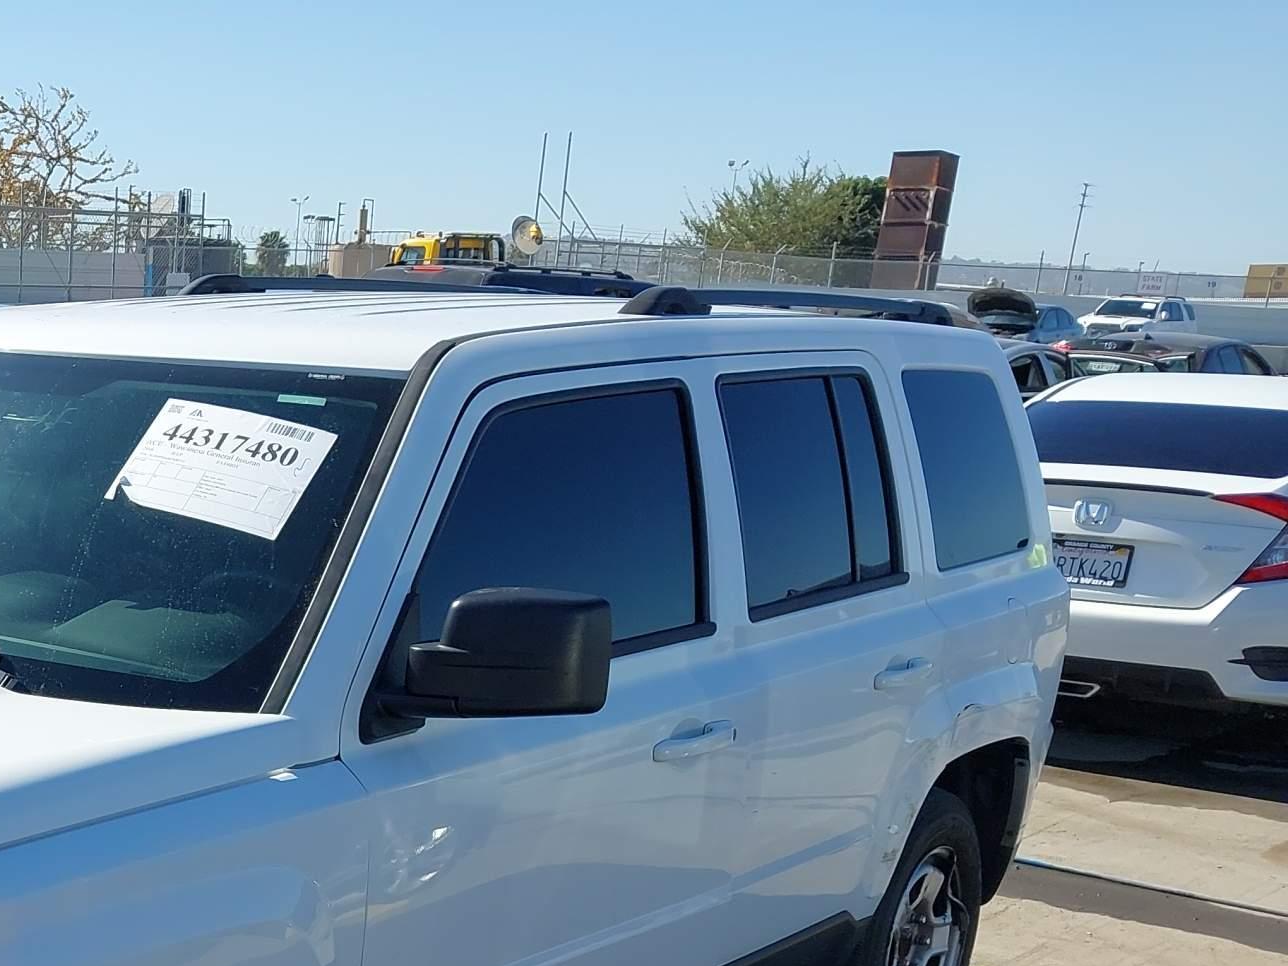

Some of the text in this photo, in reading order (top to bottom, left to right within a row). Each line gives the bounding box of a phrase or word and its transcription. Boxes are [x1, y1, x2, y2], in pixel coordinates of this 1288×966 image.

[1142, 275, 1164, 283] STATE
[163, 424, 299, 466] 44317480
[1053, 556, 1123, 581] RTK420
